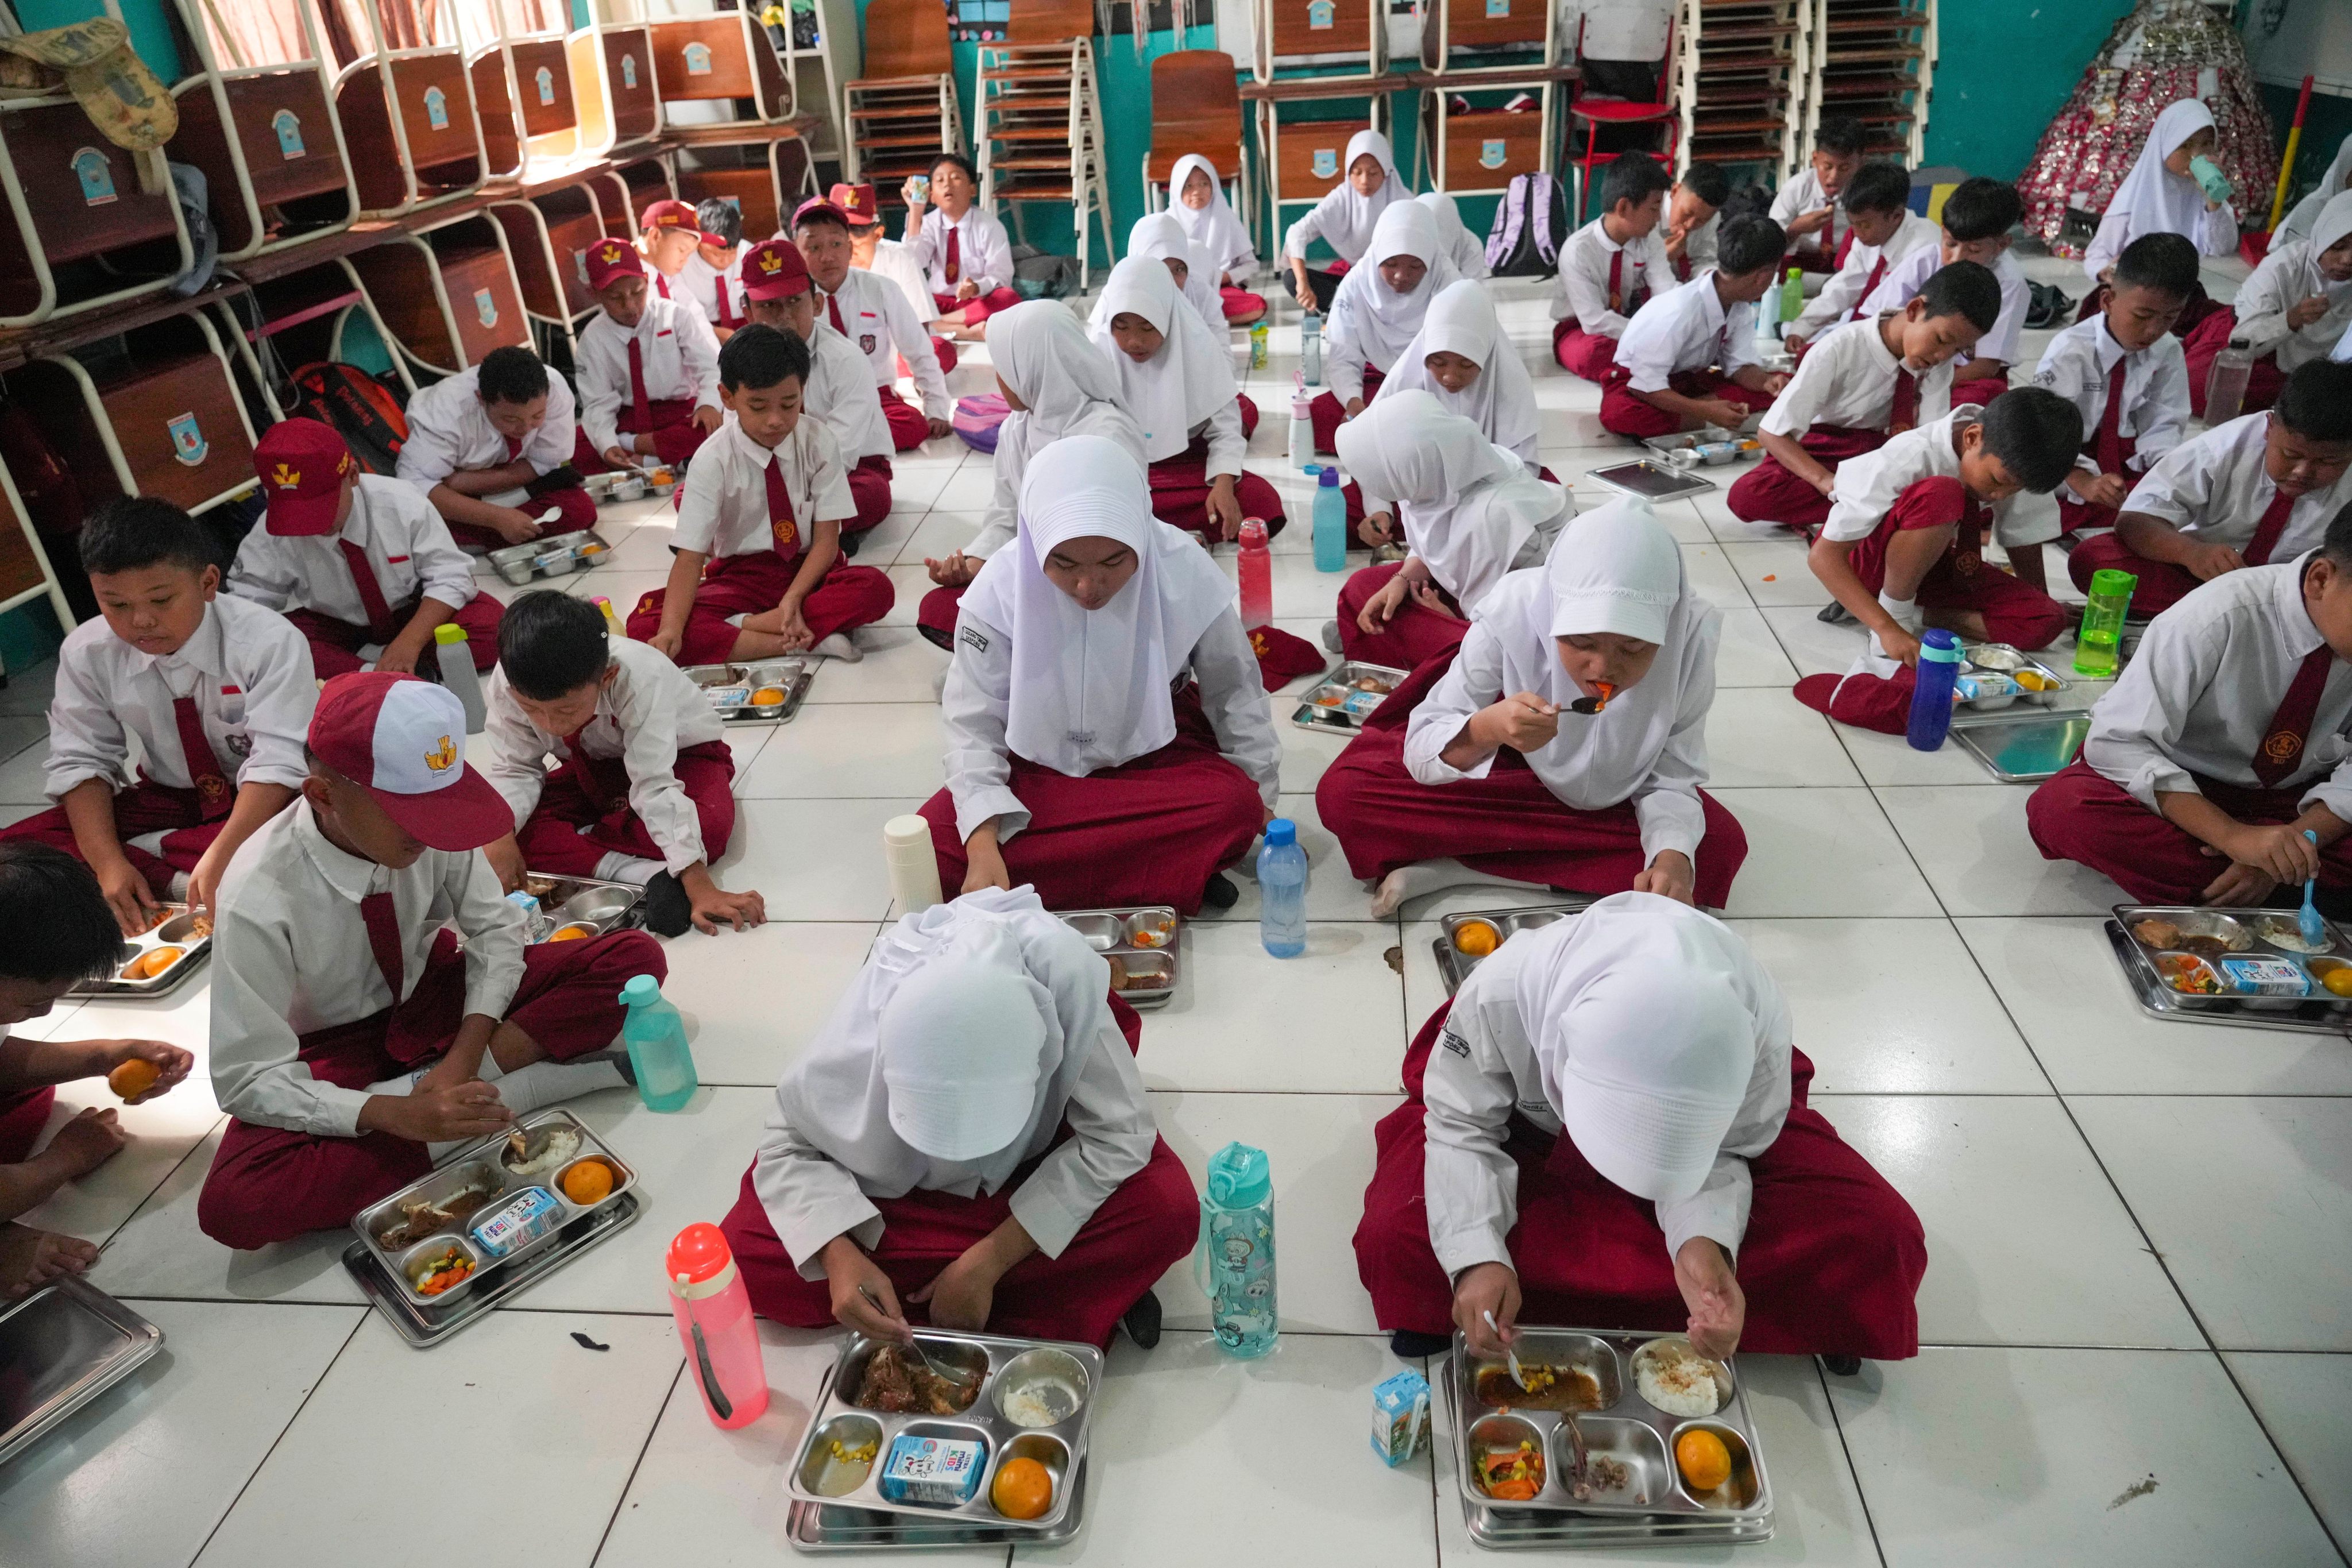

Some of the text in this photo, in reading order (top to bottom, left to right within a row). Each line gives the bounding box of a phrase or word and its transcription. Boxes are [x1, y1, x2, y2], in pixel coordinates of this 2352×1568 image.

[965, 636, 980, 647] SERPONG
[493, 1221, 508, 1233] KIDS
[945, 1449, 959, 1472] KIDS
[954, 1451, 966, 1472] mimi
[962, 1454, 972, 1469] ULTRA
